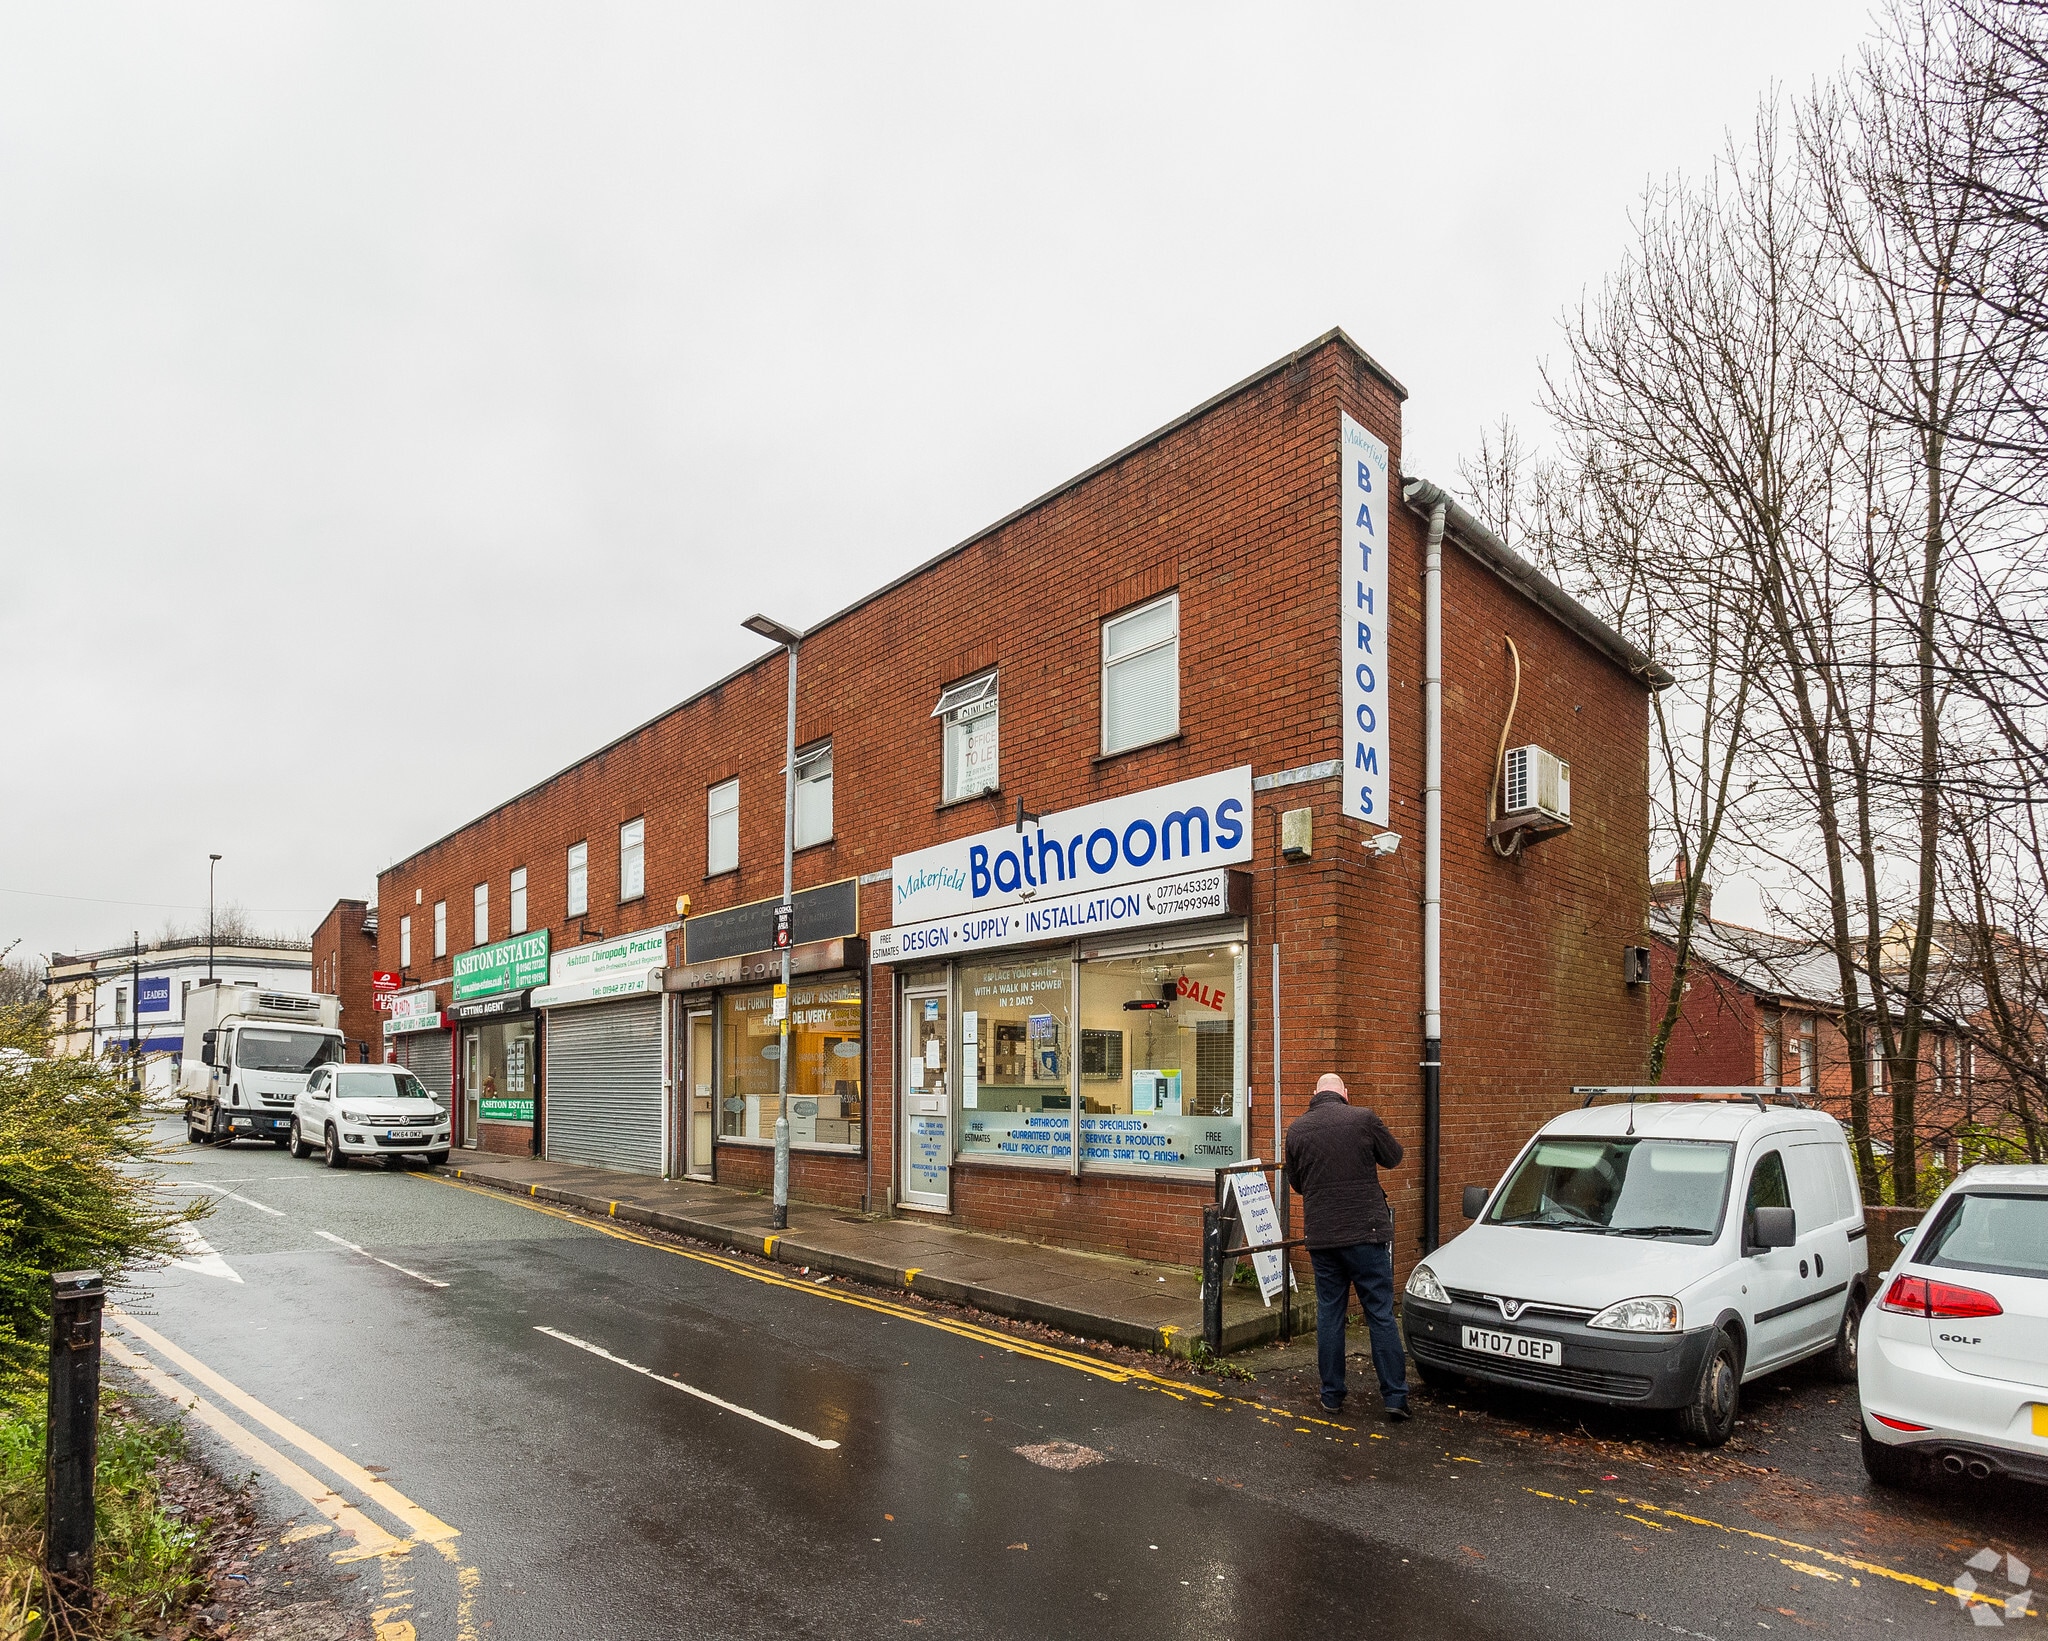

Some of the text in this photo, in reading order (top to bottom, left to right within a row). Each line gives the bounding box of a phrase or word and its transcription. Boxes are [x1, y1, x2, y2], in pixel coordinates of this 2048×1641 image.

[1343, 426, 1387, 473] Makerfield
[1355, 459, 1379, 815] BATHROOMS
[968, 730, 997, 749] OFFICE
[965, 745, 997, 767] TO LET
[969, 798, 1244, 899] Bathrooms
[897, 866, 967, 905] Makerfield
[1157, 877, 1220, 898] 07716453329
[1157, 894, 1220, 915] 07774993948
[902, 893, 1140, 952] DESIGN SUPPLY INSTALLATION
[879, 933, 892, 945] FREE
[455, 935, 546, 977] ASHTON ESTATES
[566, 937, 663, 967] Ashton Chiropody Practice
[872, 946, 900, 959] ESTIMATES
[1012, 968, 1031, 979] YOUR
[143, 989, 168, 1000] LEADERS
[592, 980, 645, 996] Tel: 01942 27 27 47
[974, 979, 1062, 997] WITH A WALK IN SHOWER
[1176, 975, 1226, 1012] SALE
[380, 1002, 393, 1010] EA
[734, 999, 746, 1011] ALL
[747, 995, 774, 1011] FURNITU
[792, 991, 816, 1006] READY
[818, 986, 860, 1003] ASSEMBLE
[999, 995, 1034, 1008] IN 2 DAYS
[459, 1001, 504, 1017] LETTING AGENT
[792, 1009, 827, 1025] DELIVERY
[1030, 1017, 1052, 1039] OPEN
[481, 1100, 534, 1109] ASHTON ESTATE
[972, 1123, 983, 1132] FREE
[1030, 1117, 1142, 1131] BATHROOM SIGN SPECIALISTS
[964, 1133, 991, 1143] ESTIMATES
[1011, 1130, 1165, 1146] GUARANTEED QUAL SERVICE & PRODUCTS
[1205, 1131, 1222, 1142] FREE
[1002, 1142, 1019, 1152] FULLY
[1021, 1143, 1048, 1155] PROJECT
[1087, 1147, 1110, 1158] FROM
[1112, 1149, 1135, 1160] START
[1138, 1150, 1150, 1161] TO
[1153, 1151, 1179, 1162] FINISH
[1194, 1145, 1234, 1156] ESTIMATES
[1238, 1182, 1269, 1198] Bathrooms
[1251, 1207, 1269, 1218] Showers
[1469, 1329, 1553, 1360] MT07 OEP
[1939, 1333, 1982, 1345] GOLF
